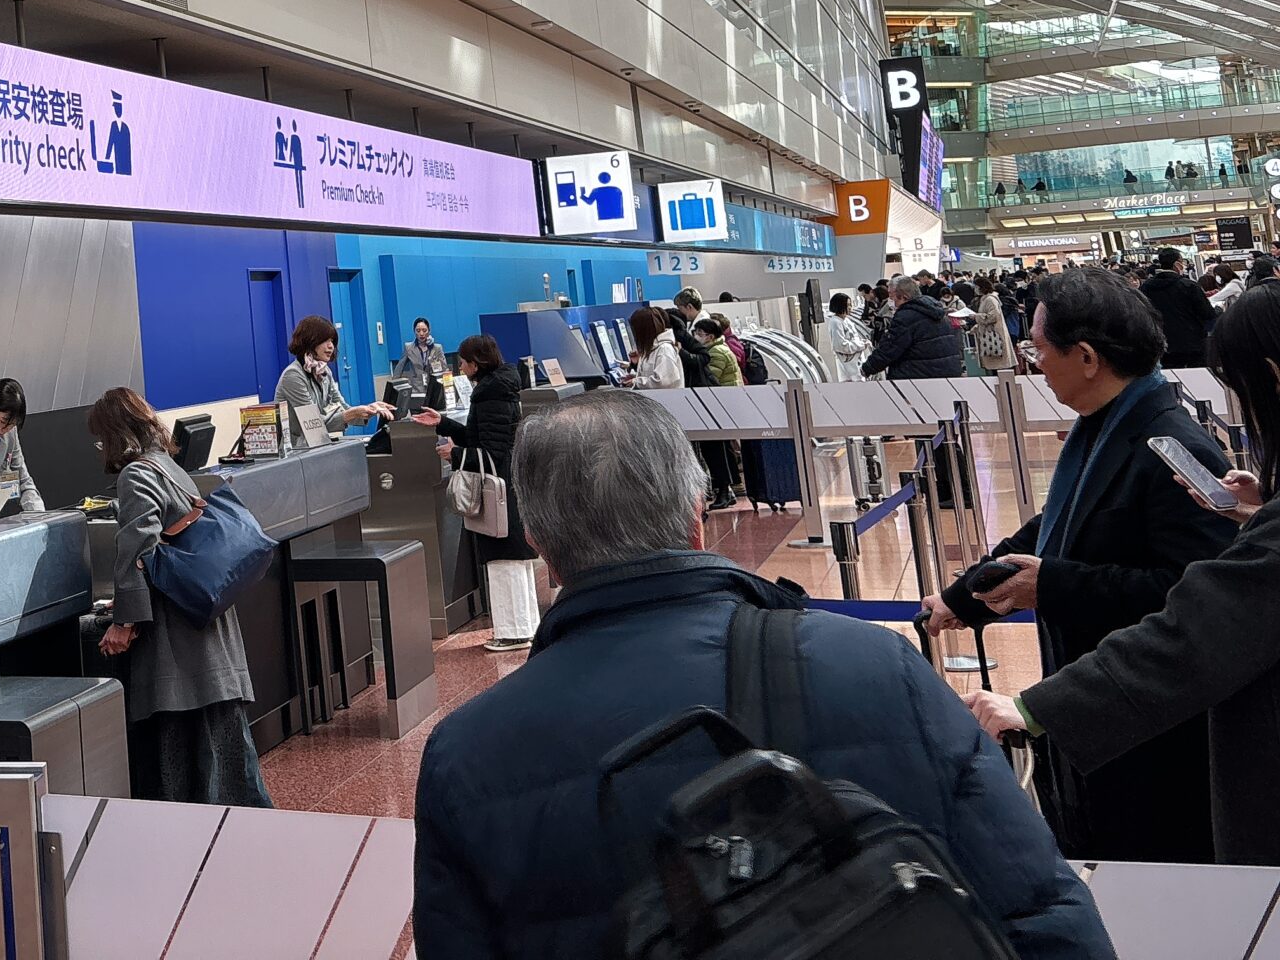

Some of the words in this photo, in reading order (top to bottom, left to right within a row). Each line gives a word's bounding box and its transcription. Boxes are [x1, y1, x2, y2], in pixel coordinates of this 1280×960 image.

[886, 70, 921, 109] B
[37, 134, 87, 172] check
[316, 134, 414, 178] プレミアムチェックイン
[610, 154, 620, 168] 6
[322, 180, 354, 202] Premium
[707, 182, 714, 192] 7
[1103, 195, 1148, 209] Market
[1151, 193, 1186, 205] Place
[848, 195, 870, 222] B
[914, 238, 923, 250] B
[1018, 237, 1079, 248] INTERNATIONAL
[951, 249, 958, 261] A
[654, 256, 661, 270] 1
[671, 256, 682, 271] 2
[689, 256, 699, 270] 3
[768, 259, 775, 270] 4
[304, 418, 322, 430] CLOSED
